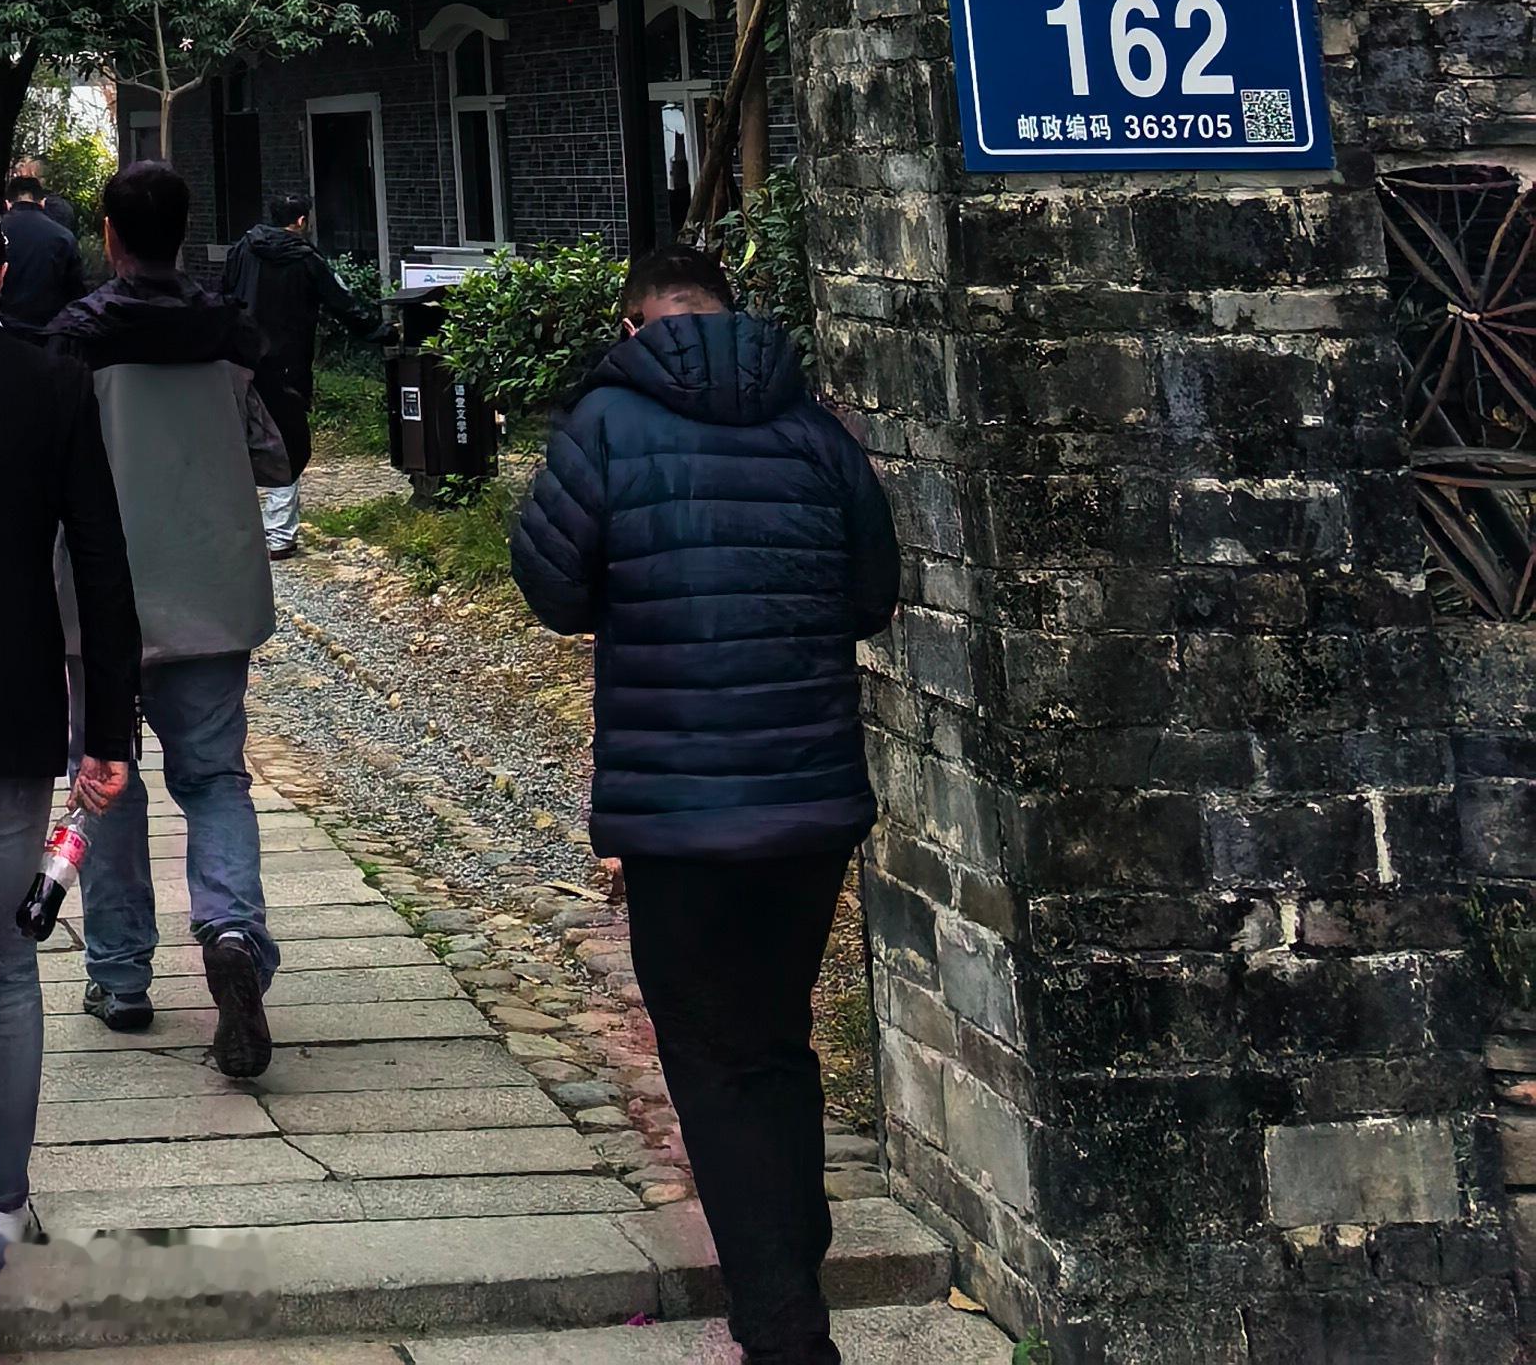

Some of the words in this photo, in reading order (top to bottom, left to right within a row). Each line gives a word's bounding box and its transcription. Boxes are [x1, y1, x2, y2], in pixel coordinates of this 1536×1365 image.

[1017, 114, 1111, 142] 邮政编码
[1124, 114, 1232, 139] 363705
